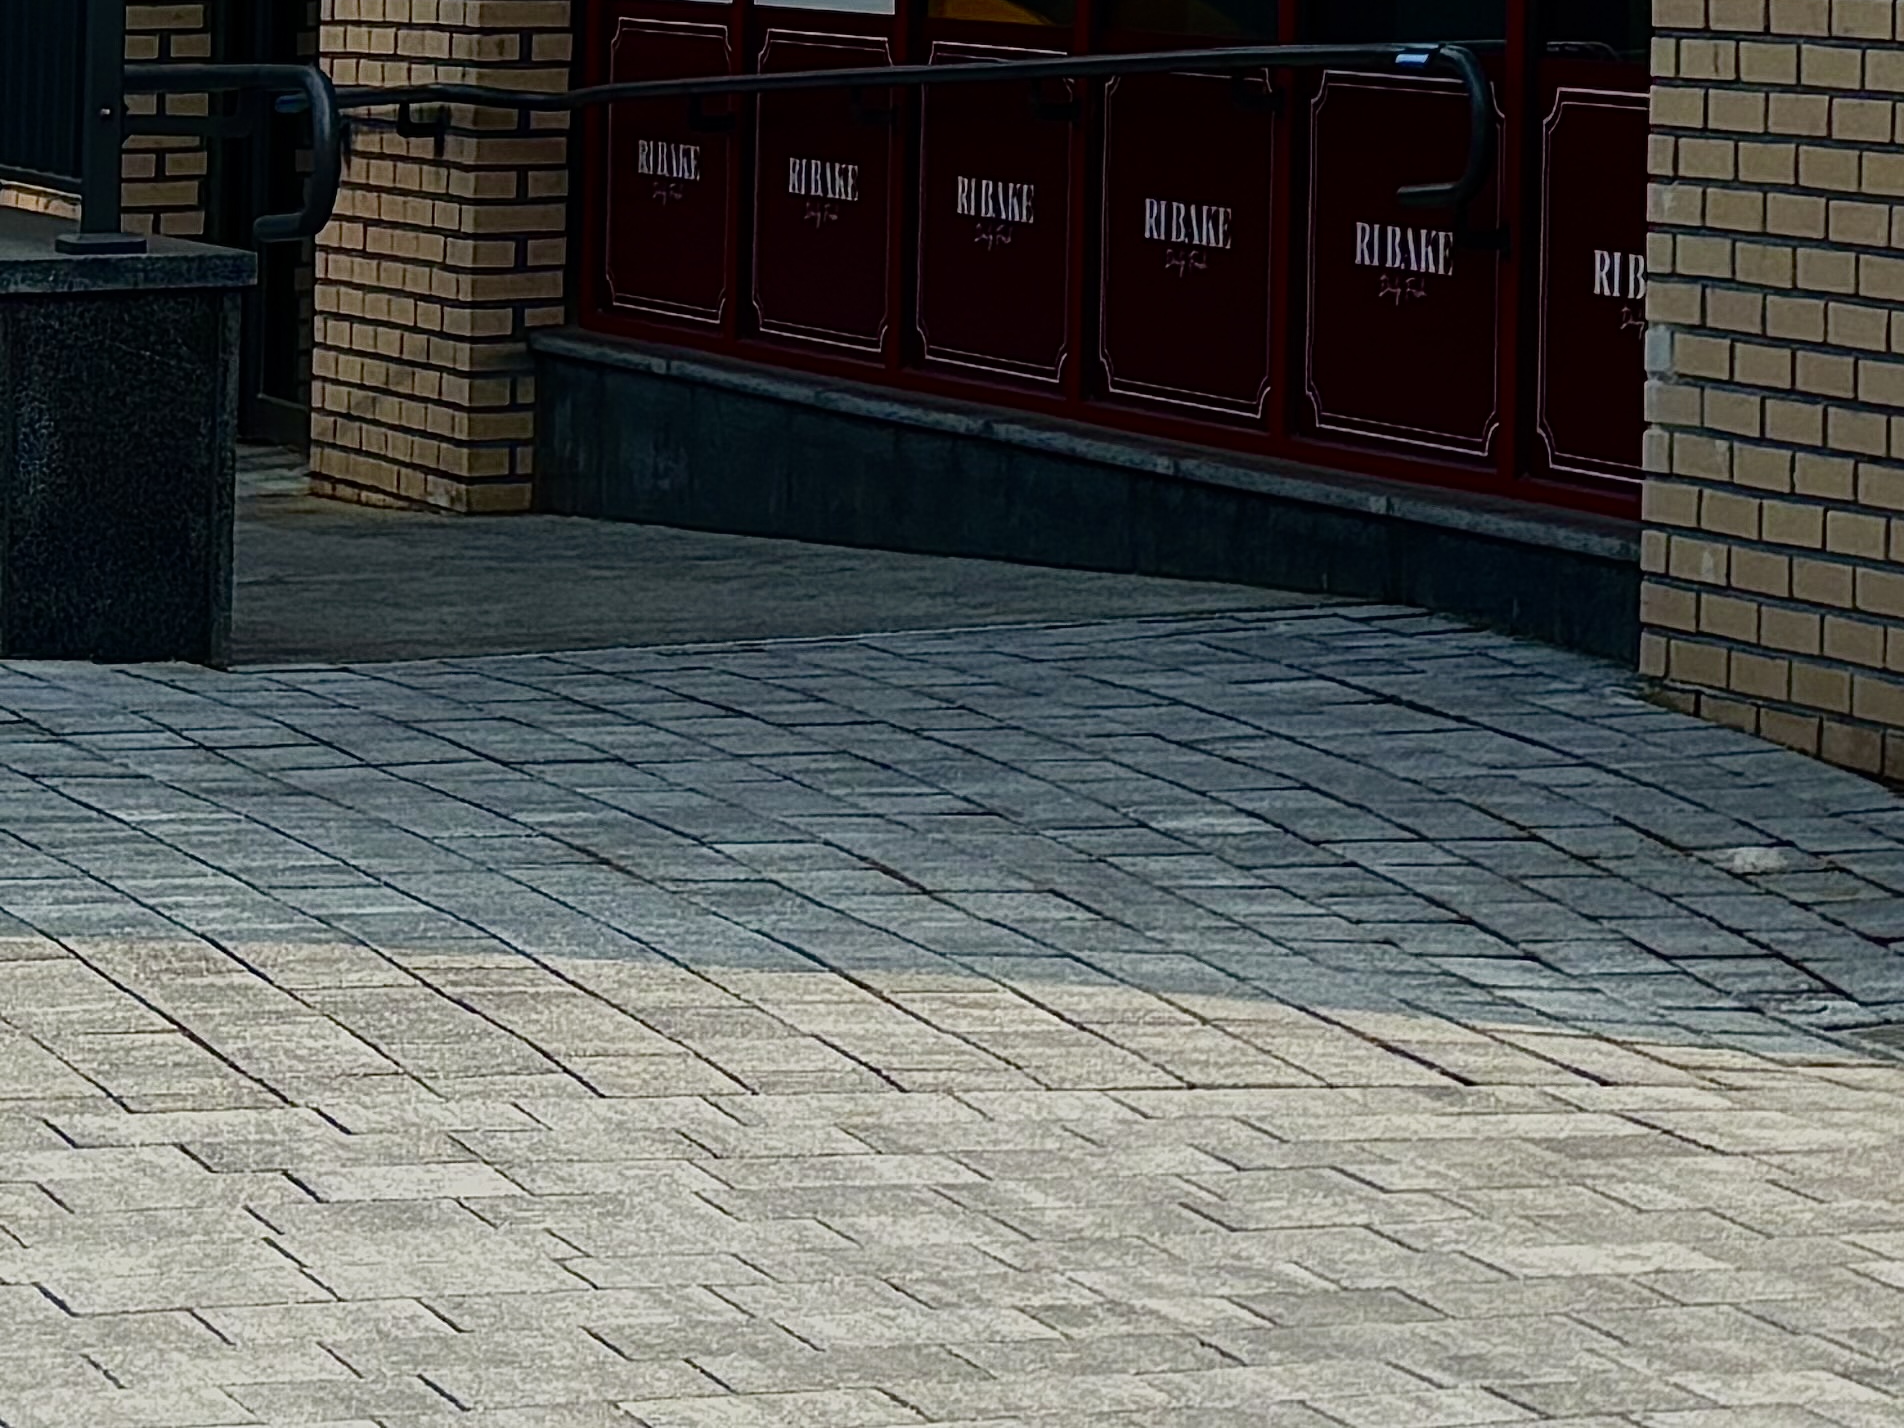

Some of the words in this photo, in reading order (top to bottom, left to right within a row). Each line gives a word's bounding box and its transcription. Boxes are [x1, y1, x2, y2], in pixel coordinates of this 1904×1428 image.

[656, 142, 700, 181] BAKE
[788, 157, 807, 195] RI
[810, 158, 859, 201] BAKE
[957, 175, 977, 216] RI
[980, 179, 1034, 223] BAKE
[1144, 197, 1168, 241] RI
[1170, 200, 1232, 250] BAKE
[1354, 221, 1381, 267] RI
[1384, 225, 1454, 276] BAKE
[1593, 249, 1622, 297] RI
